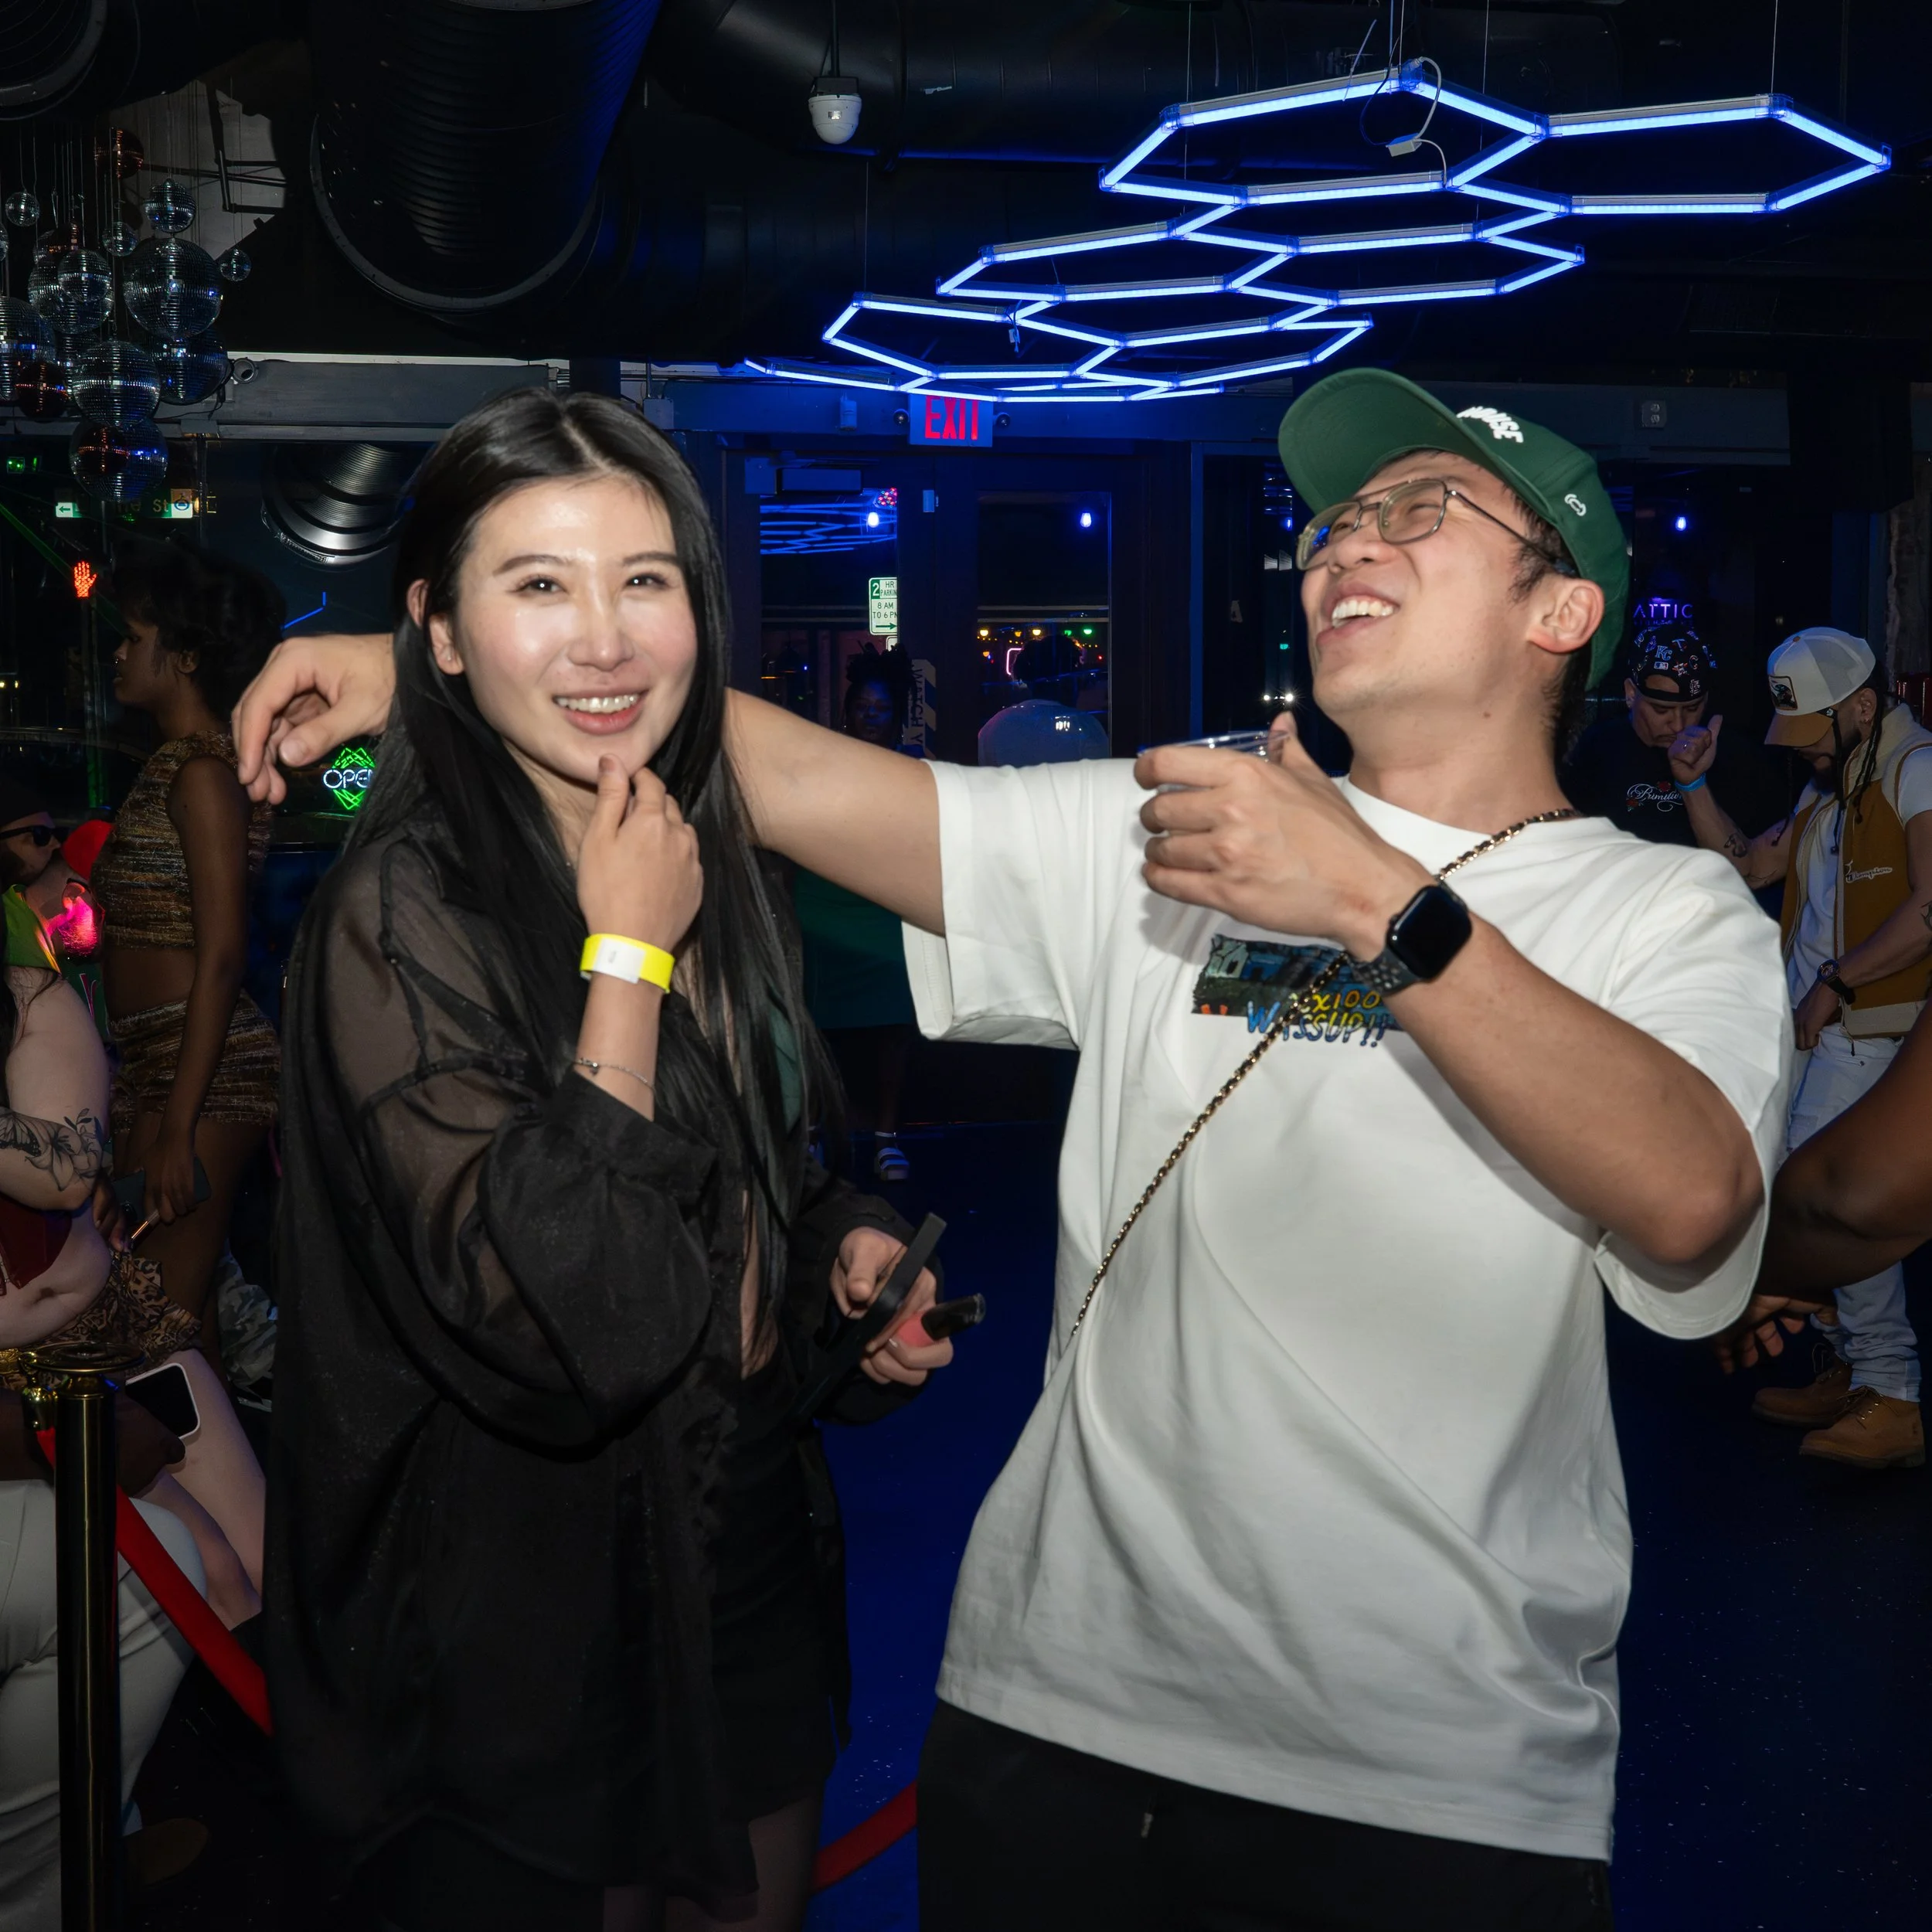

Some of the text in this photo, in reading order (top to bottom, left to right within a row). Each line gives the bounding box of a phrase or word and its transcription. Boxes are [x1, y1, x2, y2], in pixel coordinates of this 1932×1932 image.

[925, 395, 978, 440] EXIT
[872, 583, 879, 597] 2
[1632, 604, 1693, 619] ATTIC
[1627, 783, 1683, 812] Primitiv
